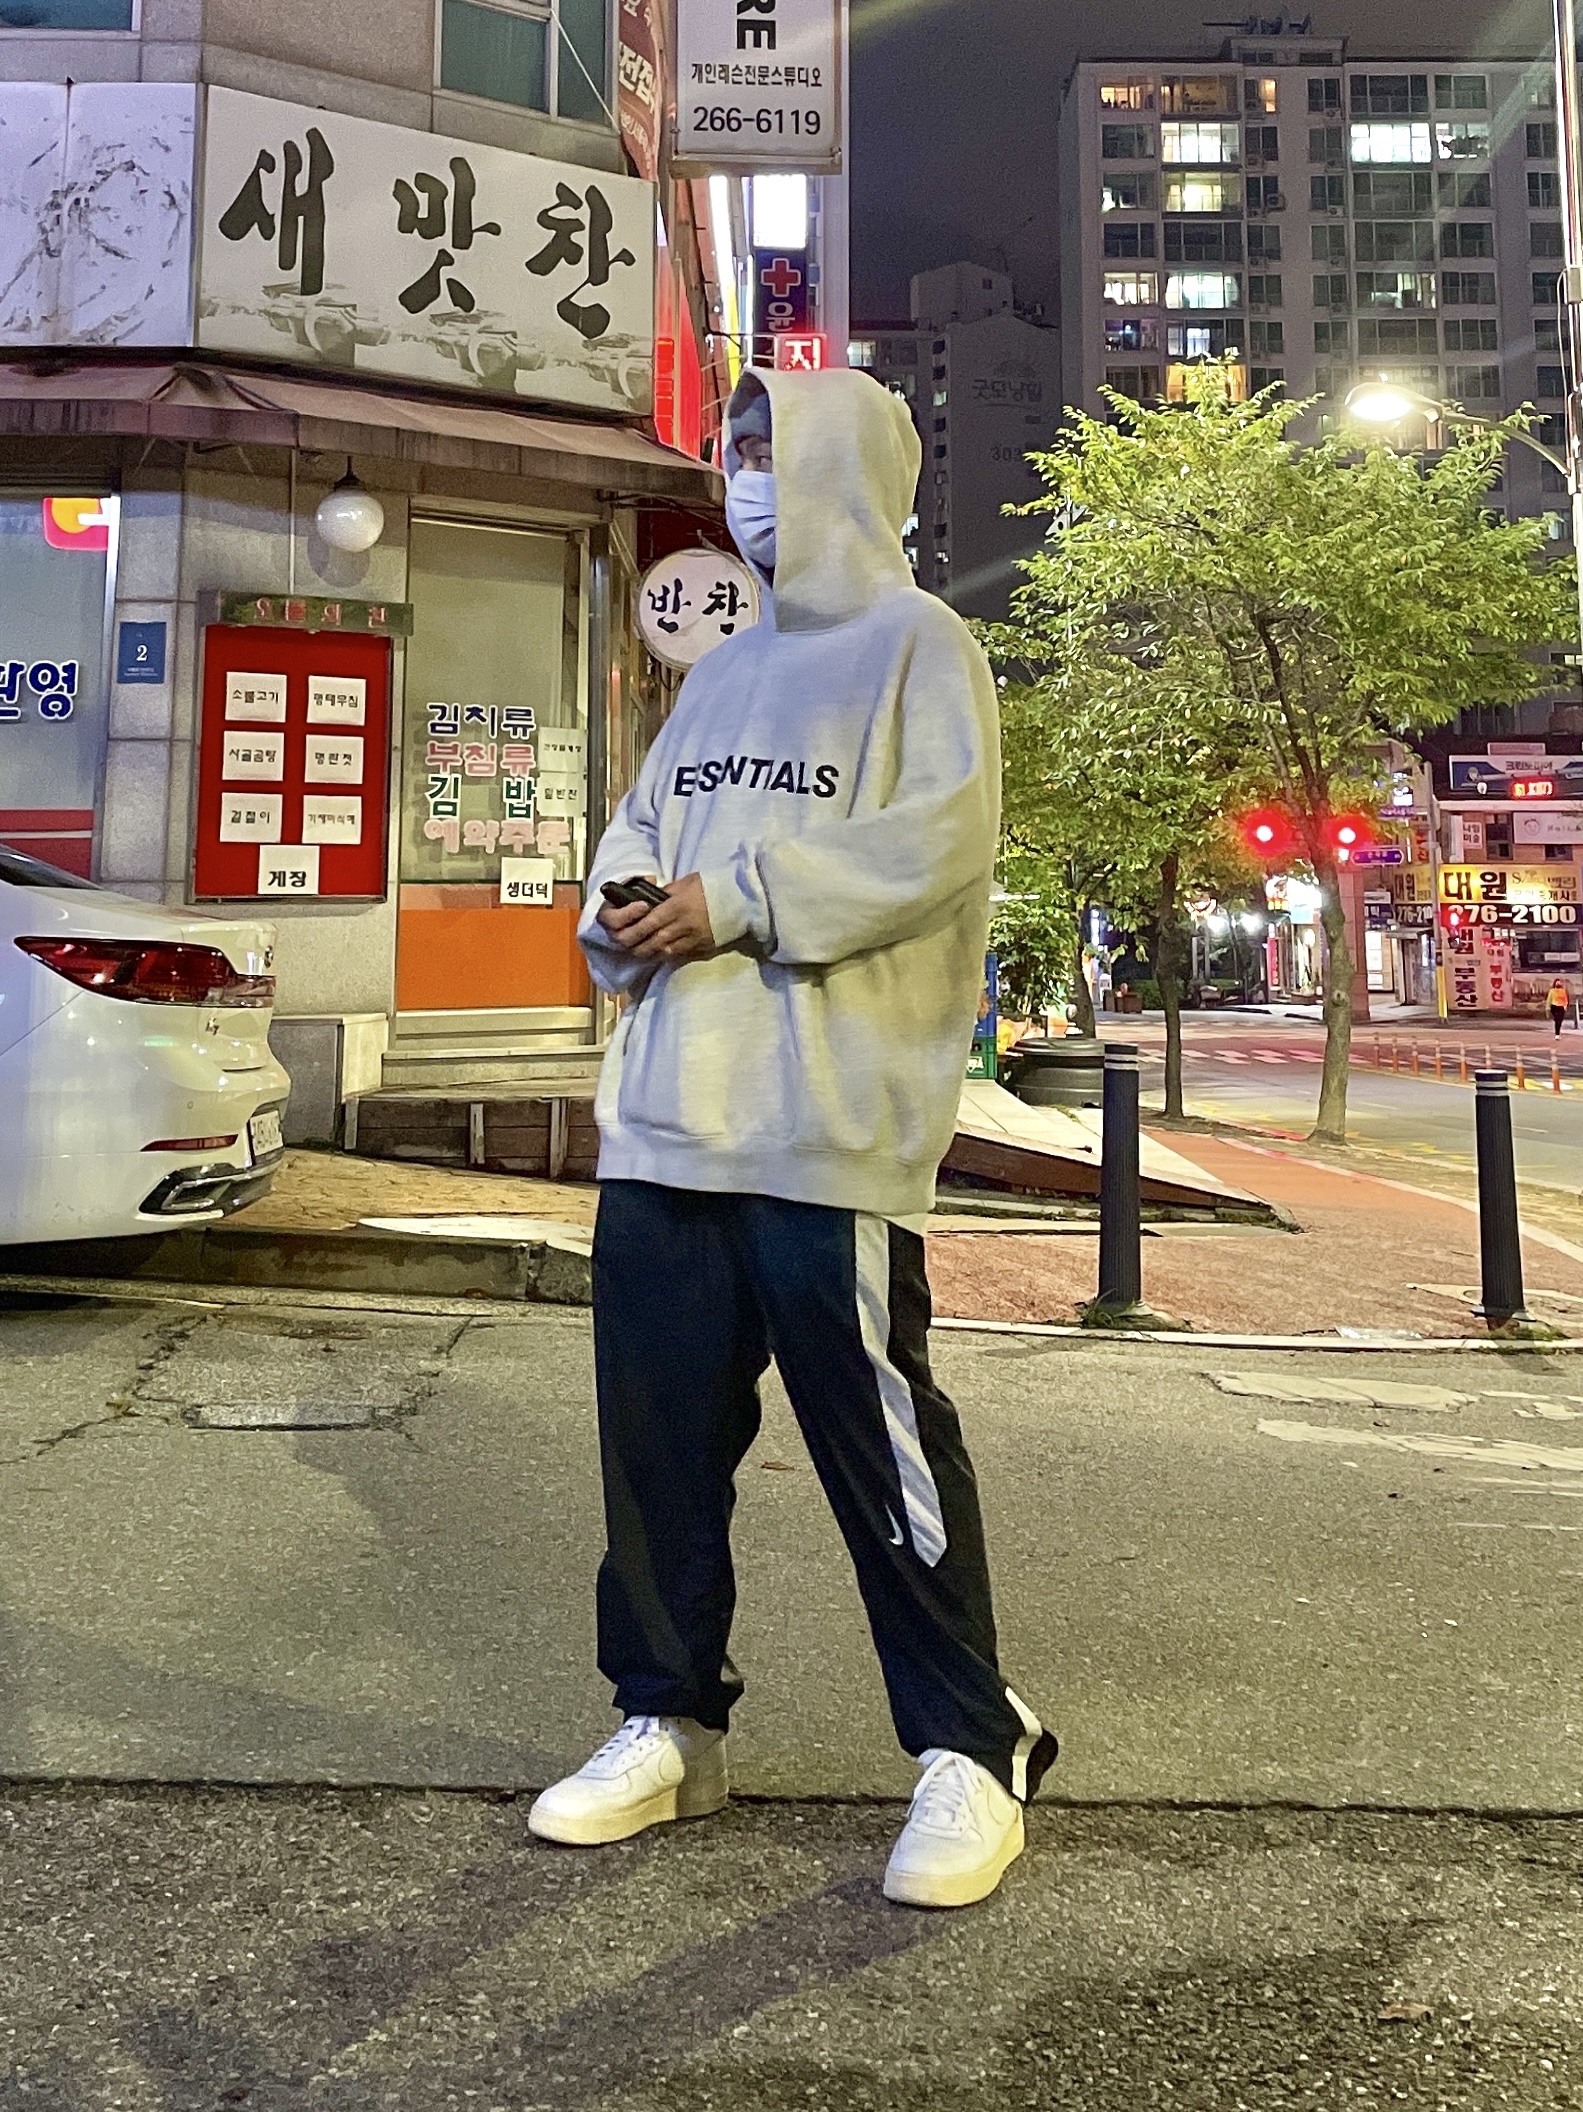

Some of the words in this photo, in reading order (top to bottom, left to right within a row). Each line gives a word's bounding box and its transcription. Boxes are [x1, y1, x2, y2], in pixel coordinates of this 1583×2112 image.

[690, 63, 822, 88] 개인레슨전문스튜디오
[692, 106, 821, 135] 266-6119
[647, 577, 749, 636] 반찬
[136, 644, 148, 661] 2
[427, 702, 536, 739] 김치류
[425, 741, 536, 777] 부침류
[423, 819, 571, 855] 예약주문
[267, 870, 307, 888] 게장
[506, 881, 549, 898] 생더덕
[1443, 871, 1508, 901] 대원
